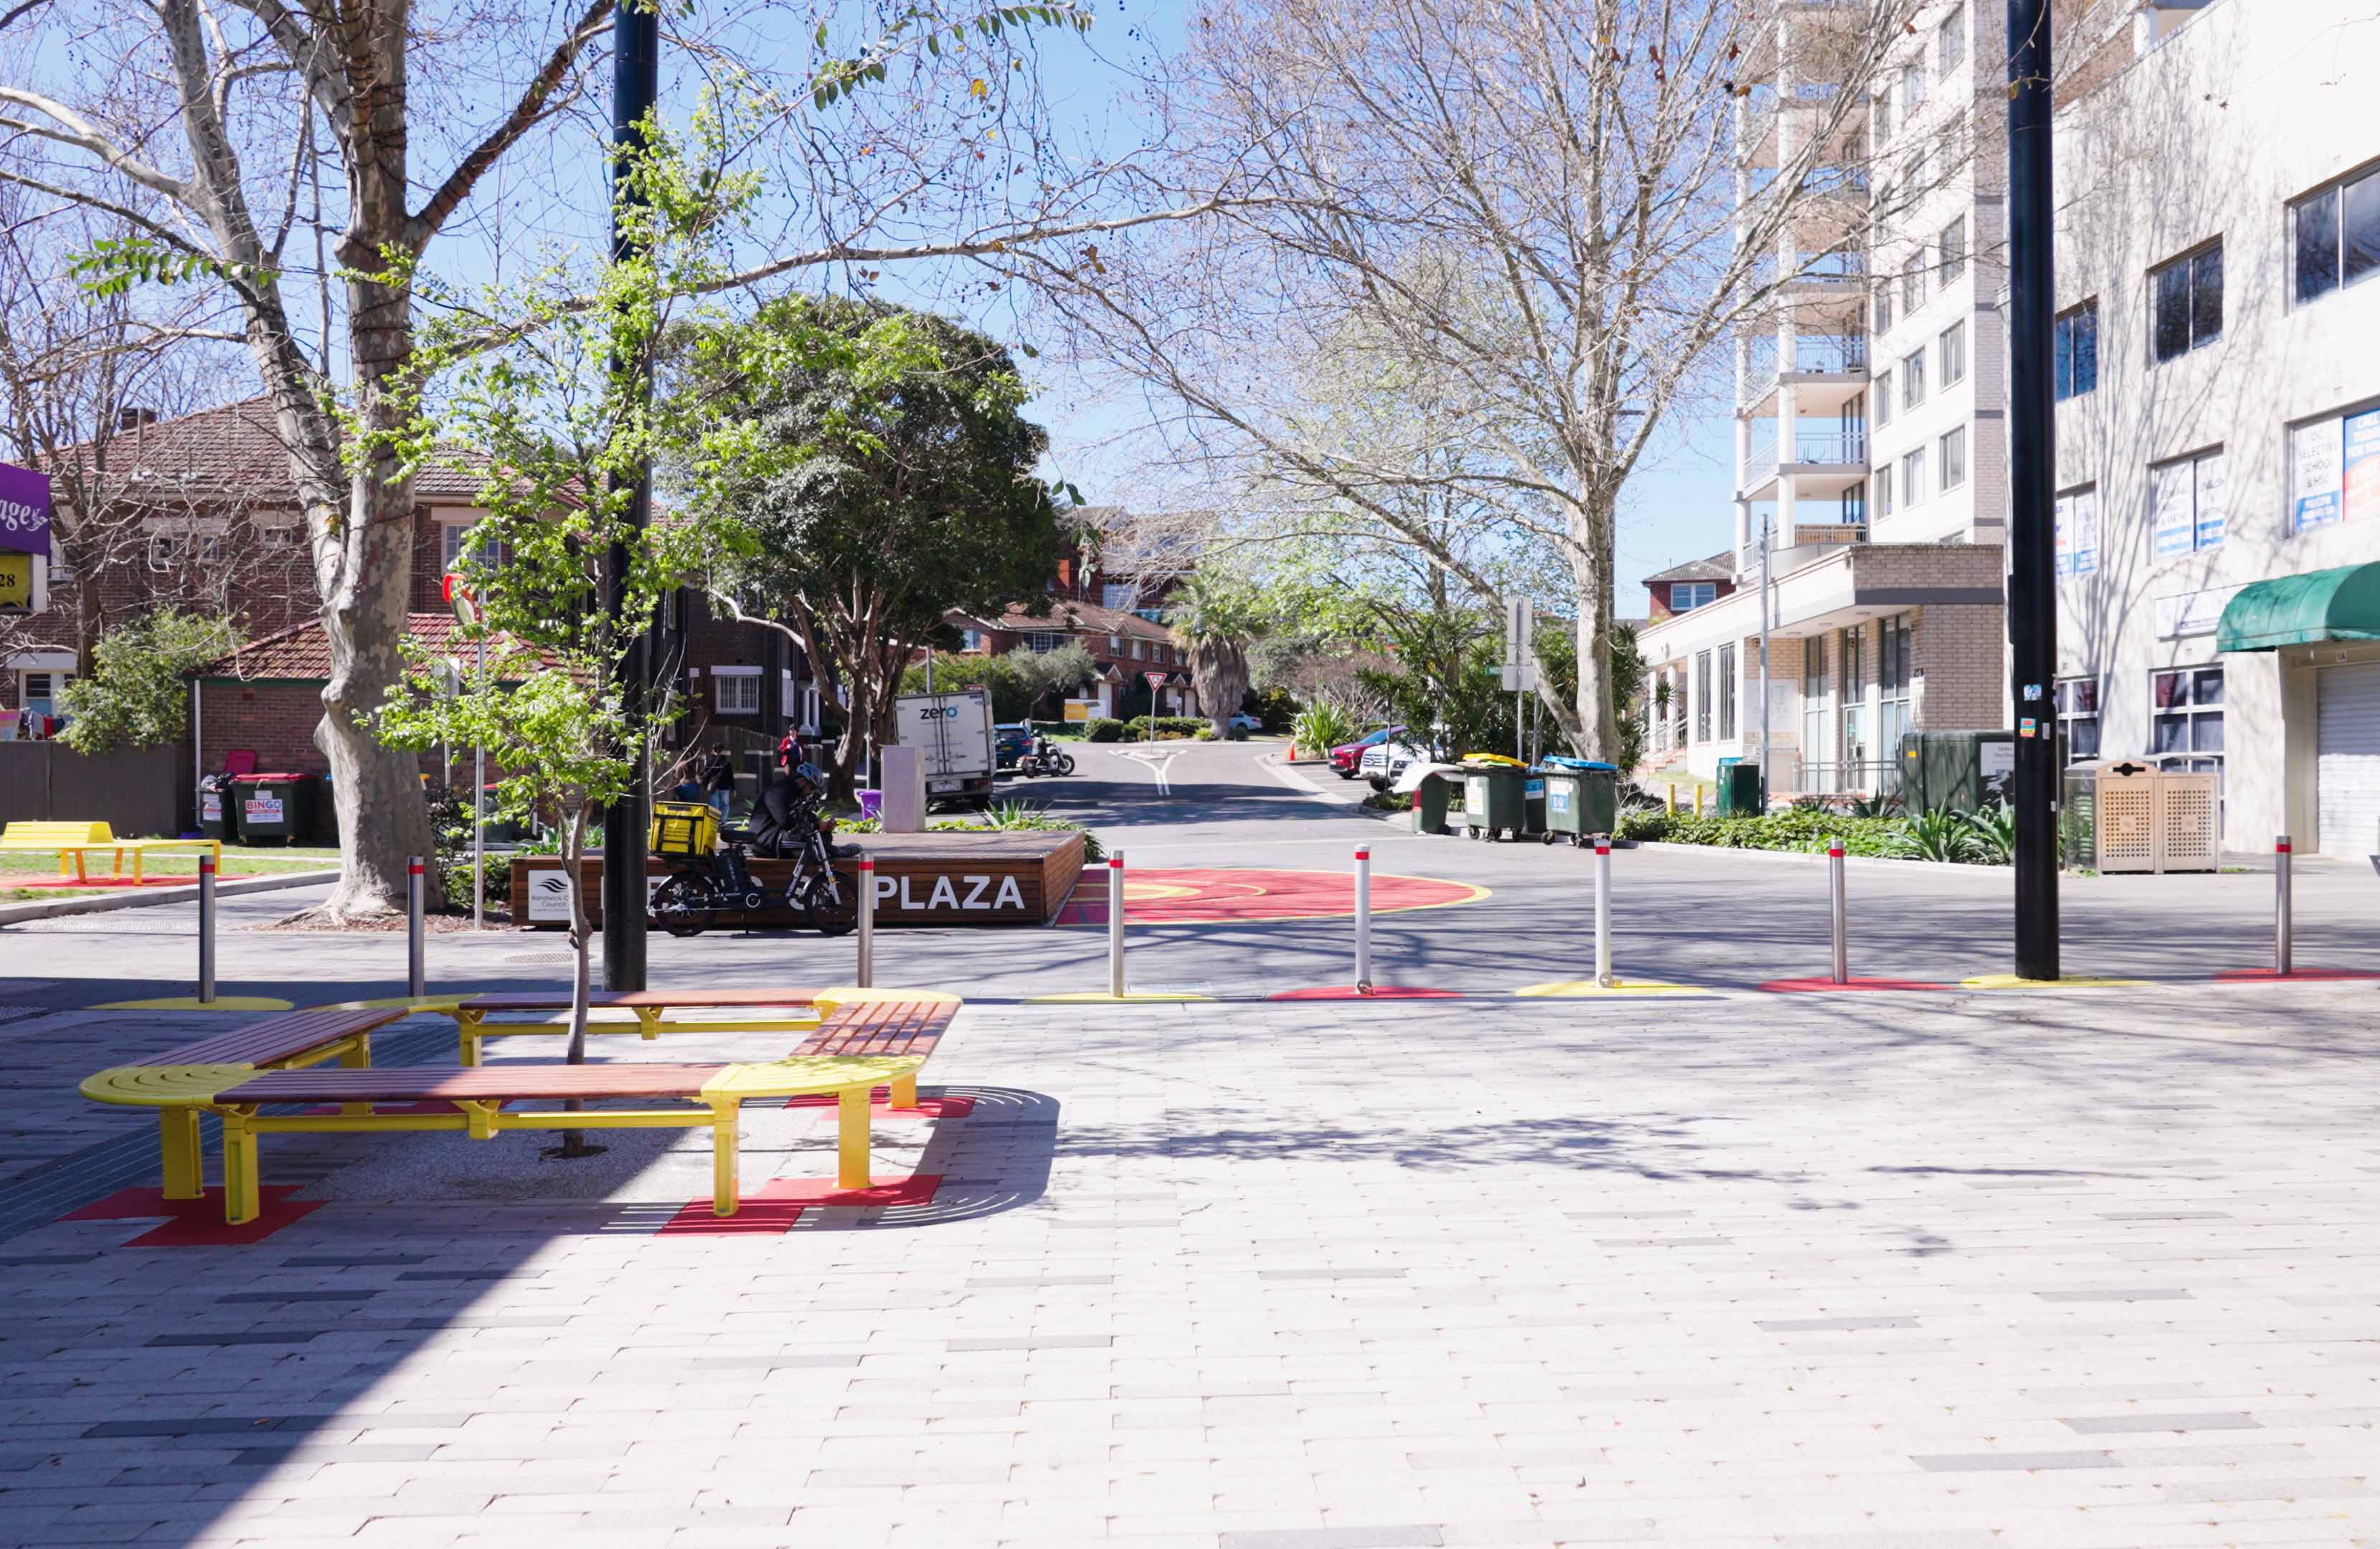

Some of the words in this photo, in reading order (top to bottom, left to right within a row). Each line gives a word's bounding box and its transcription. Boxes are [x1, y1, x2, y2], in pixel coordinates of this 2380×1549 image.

[920, 706, 958, 720] zero
[247, 800, 282, 809] BINGO
[872, 875, 1026, 910] PLAZA
